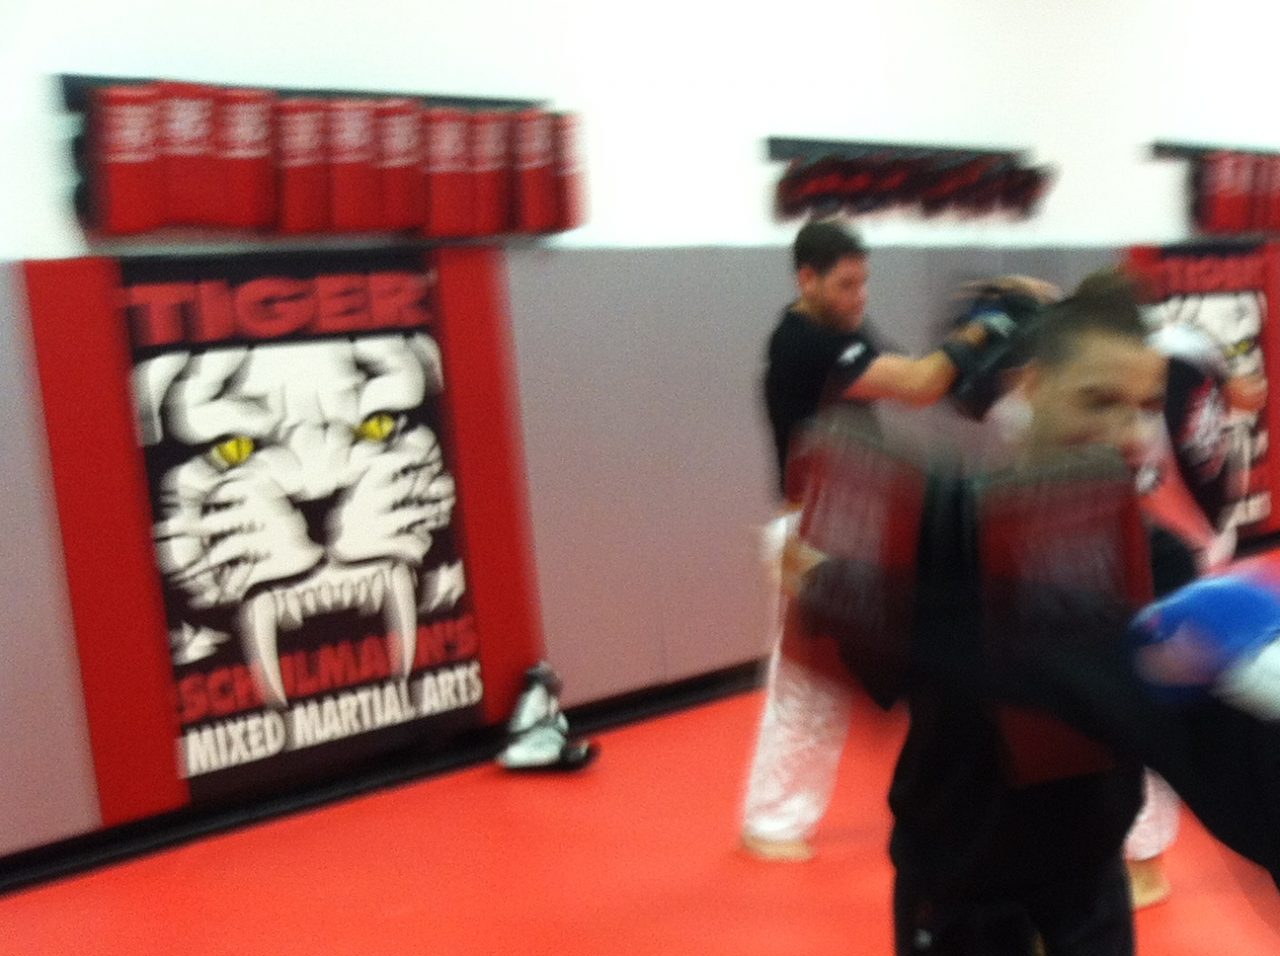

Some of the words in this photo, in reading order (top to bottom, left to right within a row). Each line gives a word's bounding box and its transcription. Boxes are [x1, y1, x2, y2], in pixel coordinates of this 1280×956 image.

[121, 271, 433, 345] TIGER
[182, 709, 286, 778] MIXED
[292, 679, 415, 750] MARTIAL
[420, 660, 483, 715] ARTS
